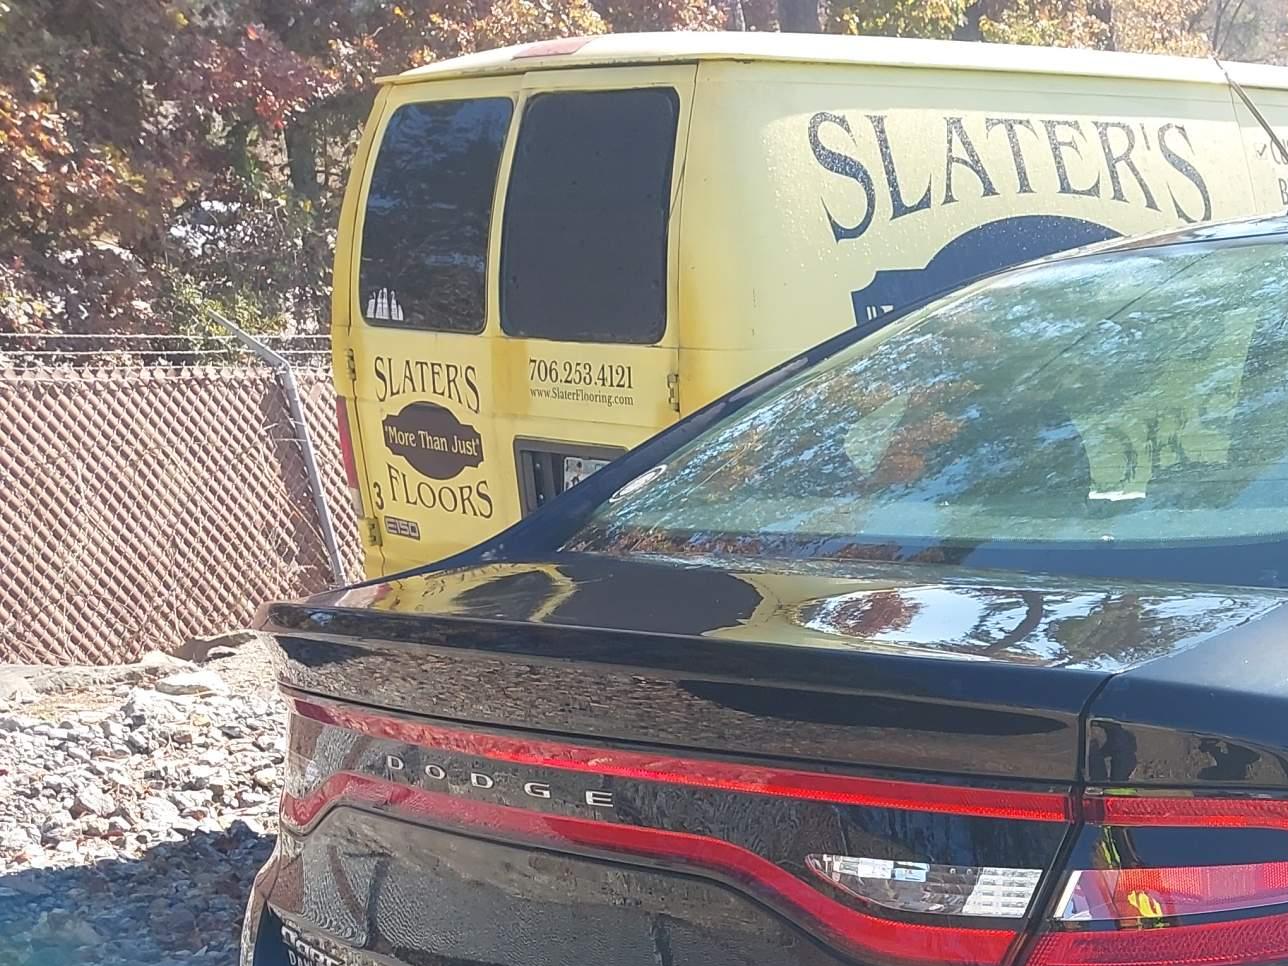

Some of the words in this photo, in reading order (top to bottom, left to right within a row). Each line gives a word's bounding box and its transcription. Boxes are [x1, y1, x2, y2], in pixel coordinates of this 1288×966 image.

[808, 111, 1212, 244] SLATER'S
[374, 356, 480, 414] SLATER'S
[529, 358, 634, 389] 706.253.4121
[530, 387, 634, 407] www.SlaterFlooring.com
[417, 430, 449, 452] Than
[373, 481, 385, 510] 3
[386, 463, 493, 519] FLOORS
[387, 755, 614, 808] DODGE
